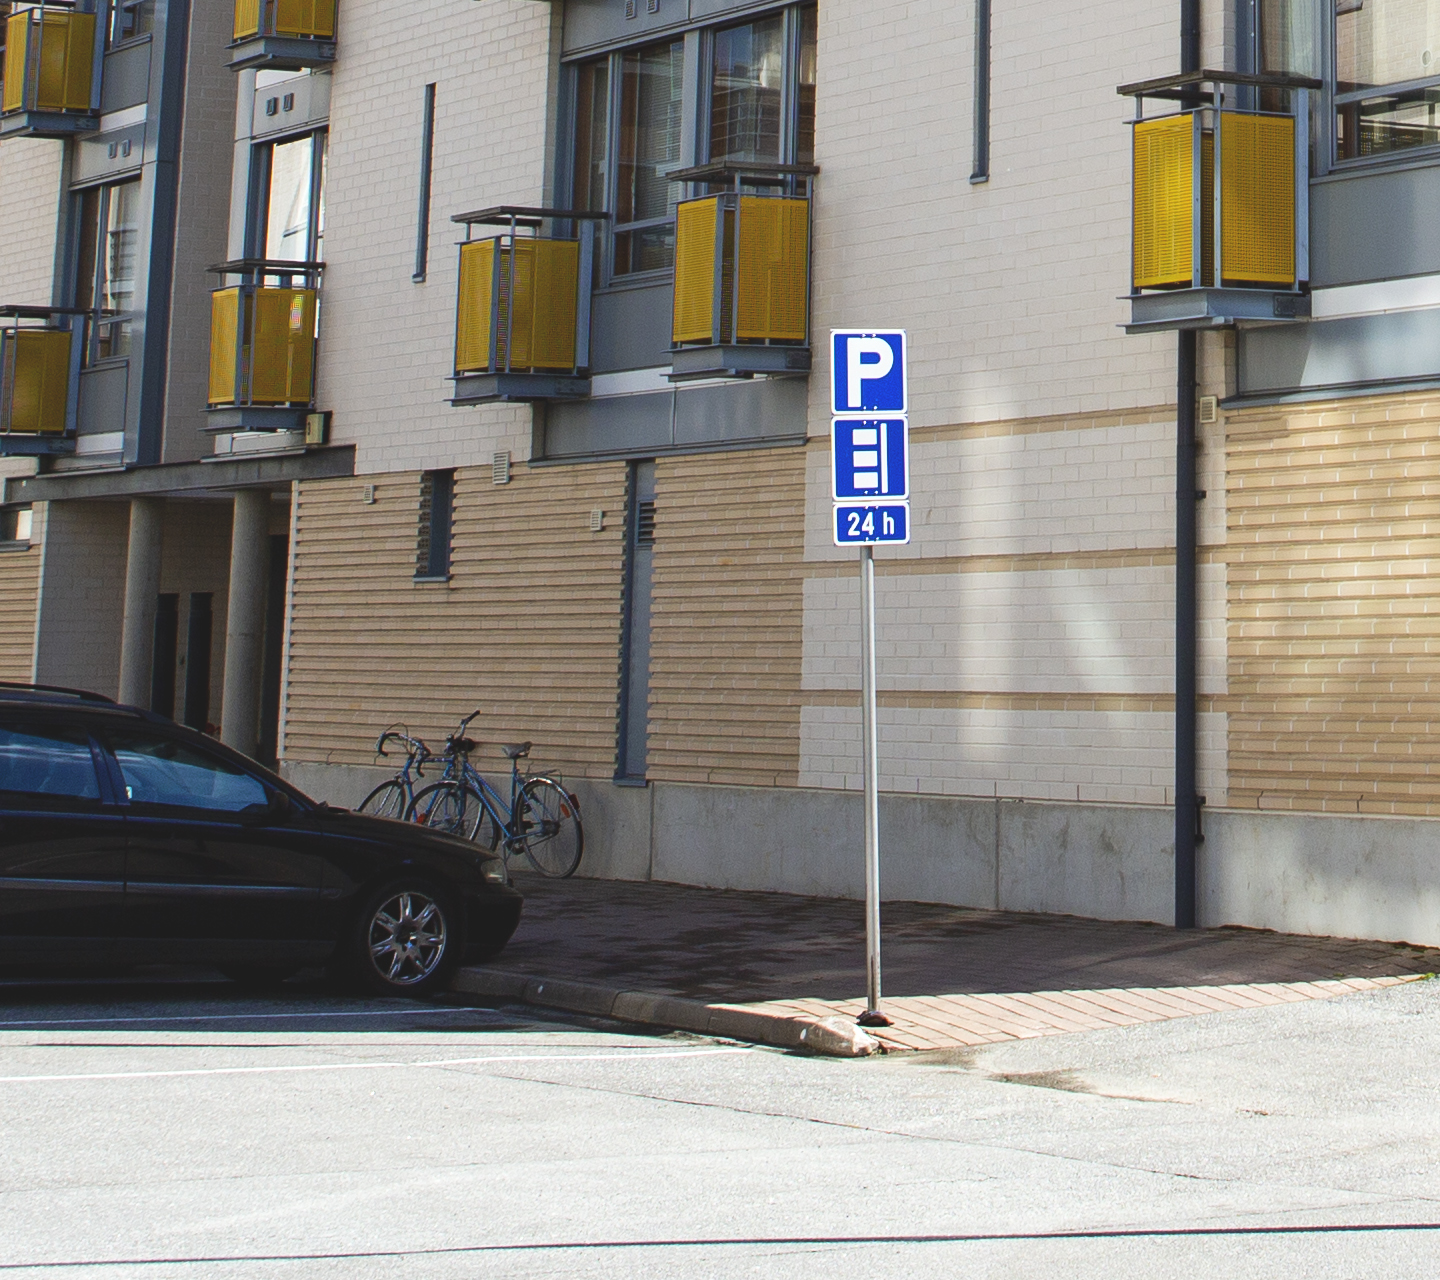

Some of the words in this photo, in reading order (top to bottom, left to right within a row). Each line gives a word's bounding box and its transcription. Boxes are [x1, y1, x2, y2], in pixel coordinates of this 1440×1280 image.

[847, 337, 894, 408] P
[847, 511, 875, 536] 24
[883, 511, 895, 535] h
